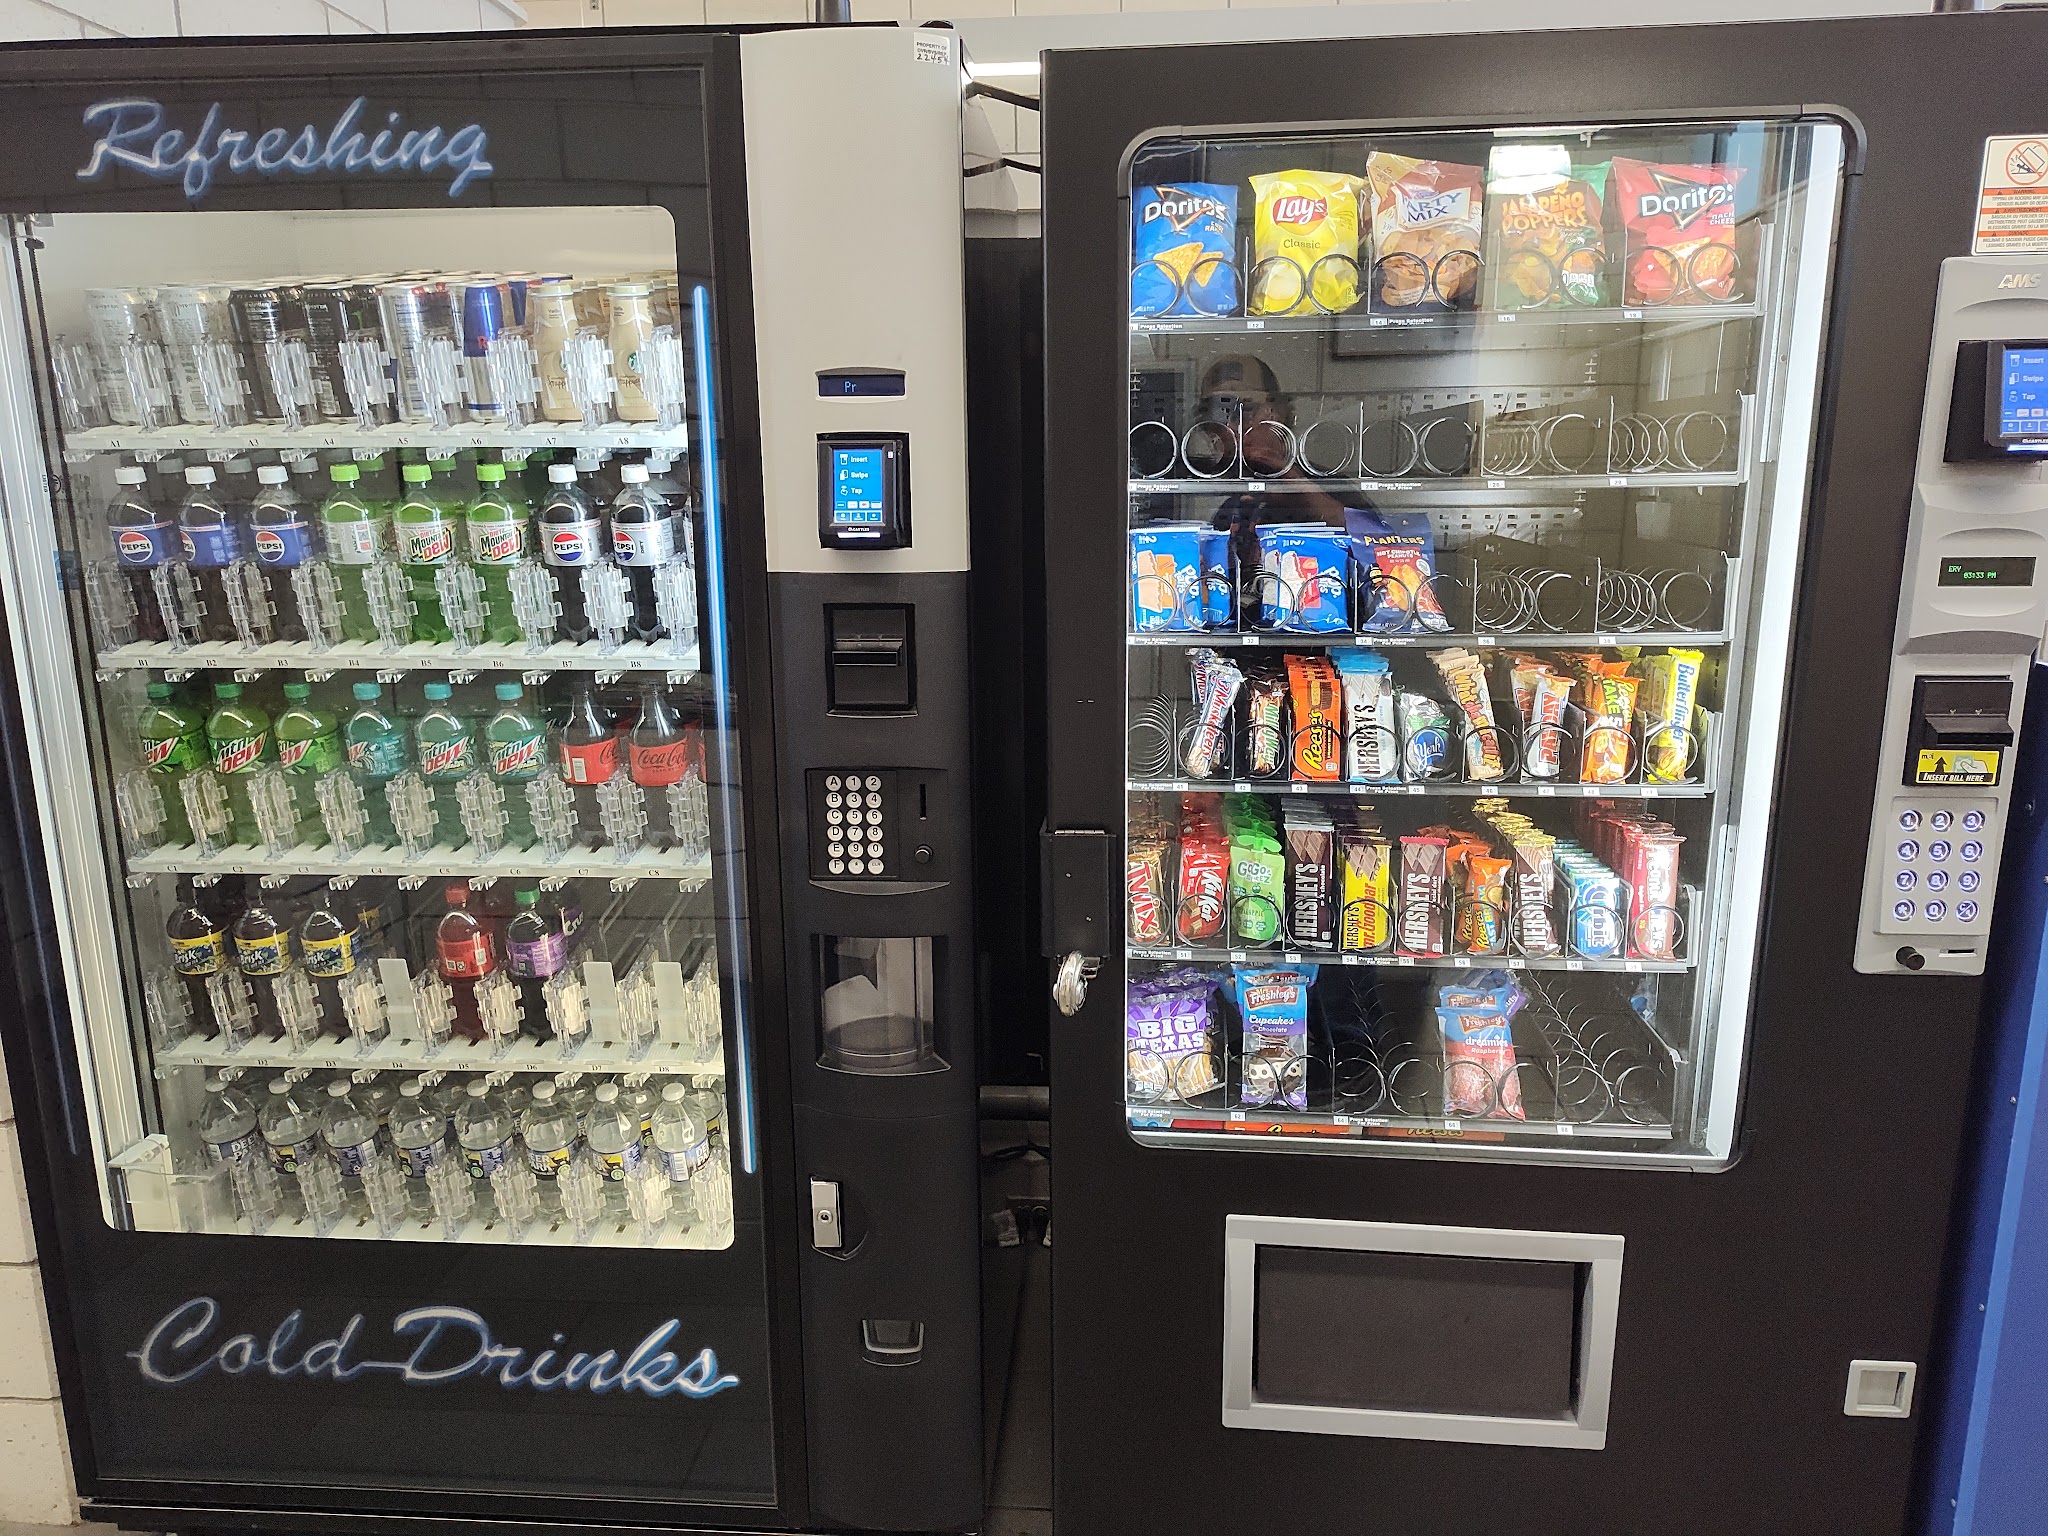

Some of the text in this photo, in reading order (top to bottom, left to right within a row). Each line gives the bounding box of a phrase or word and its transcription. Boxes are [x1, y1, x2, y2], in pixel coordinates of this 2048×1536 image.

[76, 97, 494, 198] Refreshing
[1144, 198, 1228, 223] Doritos
[1276, 196, 1327, 225] Lay's
[1407, 205, 1449, 222] MIX
[1502, 206, 1586, 236] POPPERS
[1712, 212, 1735, 220] NACH
[1283, 239, 1321, 249] Classic
[1998, 273, 2042, 289] AMS
[844, 381, 857, 393] Pr
[2022, 393, 2036, 401] Tap
[110, 440, 121, 448] A1
[178, 439, 190, 447] A2
[248, 439, 259, 447] A3
[323, 439, 335, 447] A4
[397, 437, 409, 445] A5
[470, 437, 482, 445] A6
[545, 437, 557, 445] A7
[617, 437, 629, 445] A8
[850, 455, 868, 463] Insert
[850, 471, 869, 480] Swipe
[850, 487, 863, 495] Tap
[1364, 536, 1425, 546] PLANTERS
[121, 542, 150, 551] PEPSI
[257, 542, 284, 551] PEPSI
[553, 542, 583, 551] PEPSI
[1948, 565, 1962, 573] ERY
[138, 659, 148, 667] B1
[206, 659, 217, 667] B2
[277, 659, 288, 667] B3
[348, 659, 360, 667] B4
[630, 660, 642, 668] B8
[1602, 679, 1620, 715] TAKE
[1672, 663, 1695, 743] Butterfinger
[1263, 703, 1280, 737] Milky
[1302, 709, 1324, 770] Reese's
[1414, 736, 1441, 770] York
[1923, 773, 1948, 781] INSERT
[1966, 774, 1984, 782] HERE
[1198, 871, 1223, 922] Kit Kat
[1294, 863, 1318, 938] HERSHEY'S
[1404, 872, 1431, 950] HERSHEY'S
[1519, 873, 1548, 949] HERSHEY'S
[565, 911, 584, 937] Cru
[1345, 904, 1360, 948] HERSHEY'S
[1250, 988, 1296, 1005] Freshley's
[1249, 1014, 1295, 1026] Cupcakes
[1138, 1014, 1197, 1038] BIG
[1136, 1031, 1204, 1053] TEXAS
[1466, 1036, 1508, 1048] dreamies
[1471, 1047, 1506, 1055] Raspberry
[529, 1154, 550, 1163] EER
[127, 1296, 739, 1398] Cold Drinks
